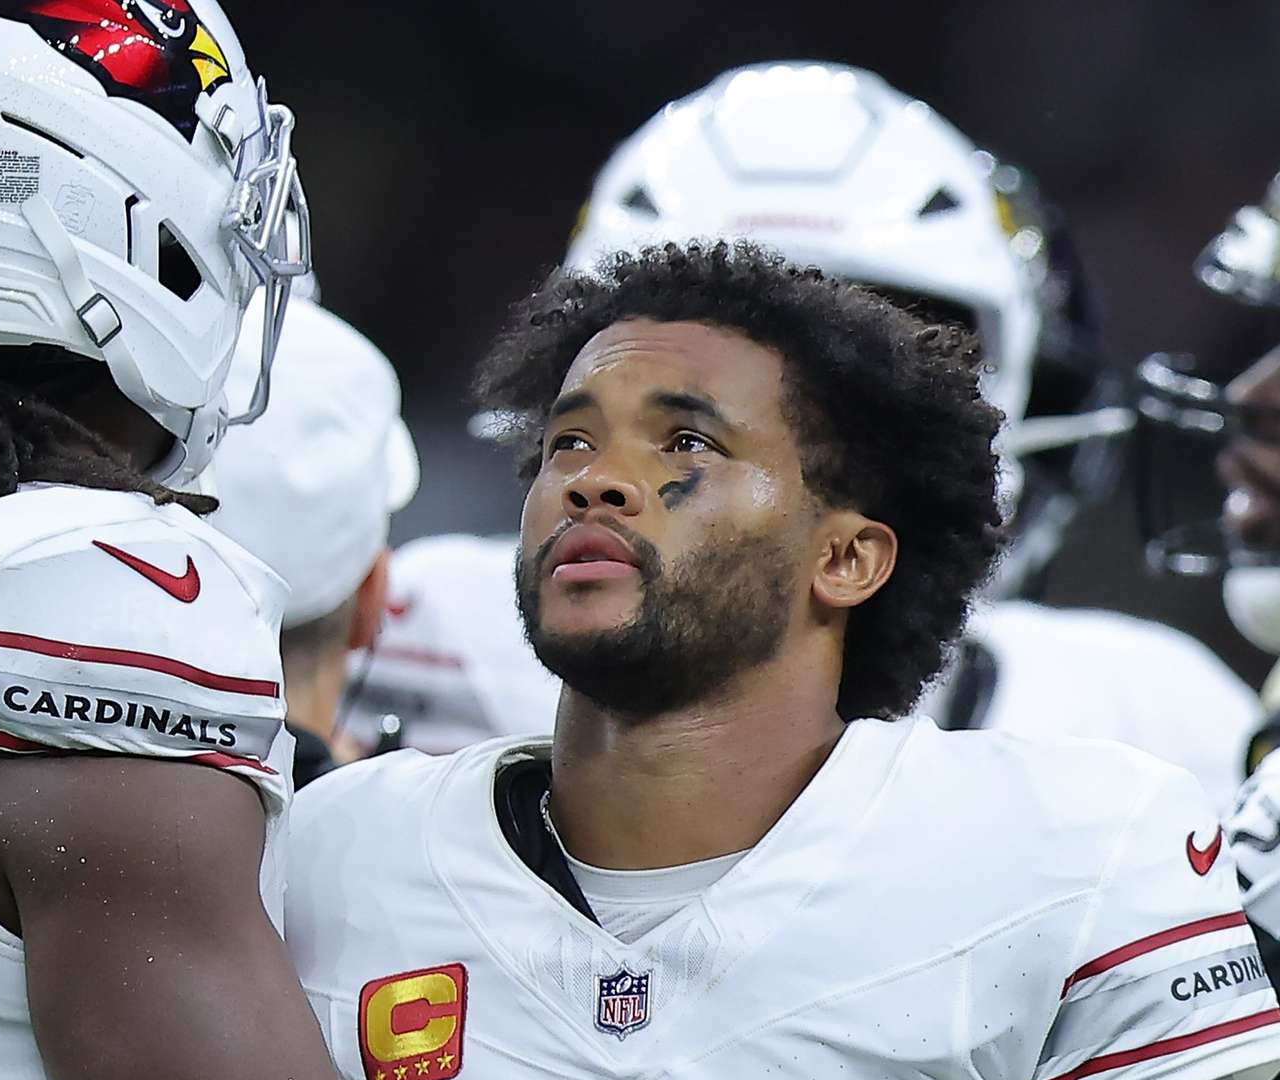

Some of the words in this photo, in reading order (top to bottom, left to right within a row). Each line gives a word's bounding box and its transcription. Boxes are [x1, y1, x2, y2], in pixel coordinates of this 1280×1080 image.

[3, 685, 237, 747] CARDINALS
[1170, 955, 1267, 1002] CARDIN
[366, 973, 458, 1062] C
[603, 996, 642, 1025] NFL
